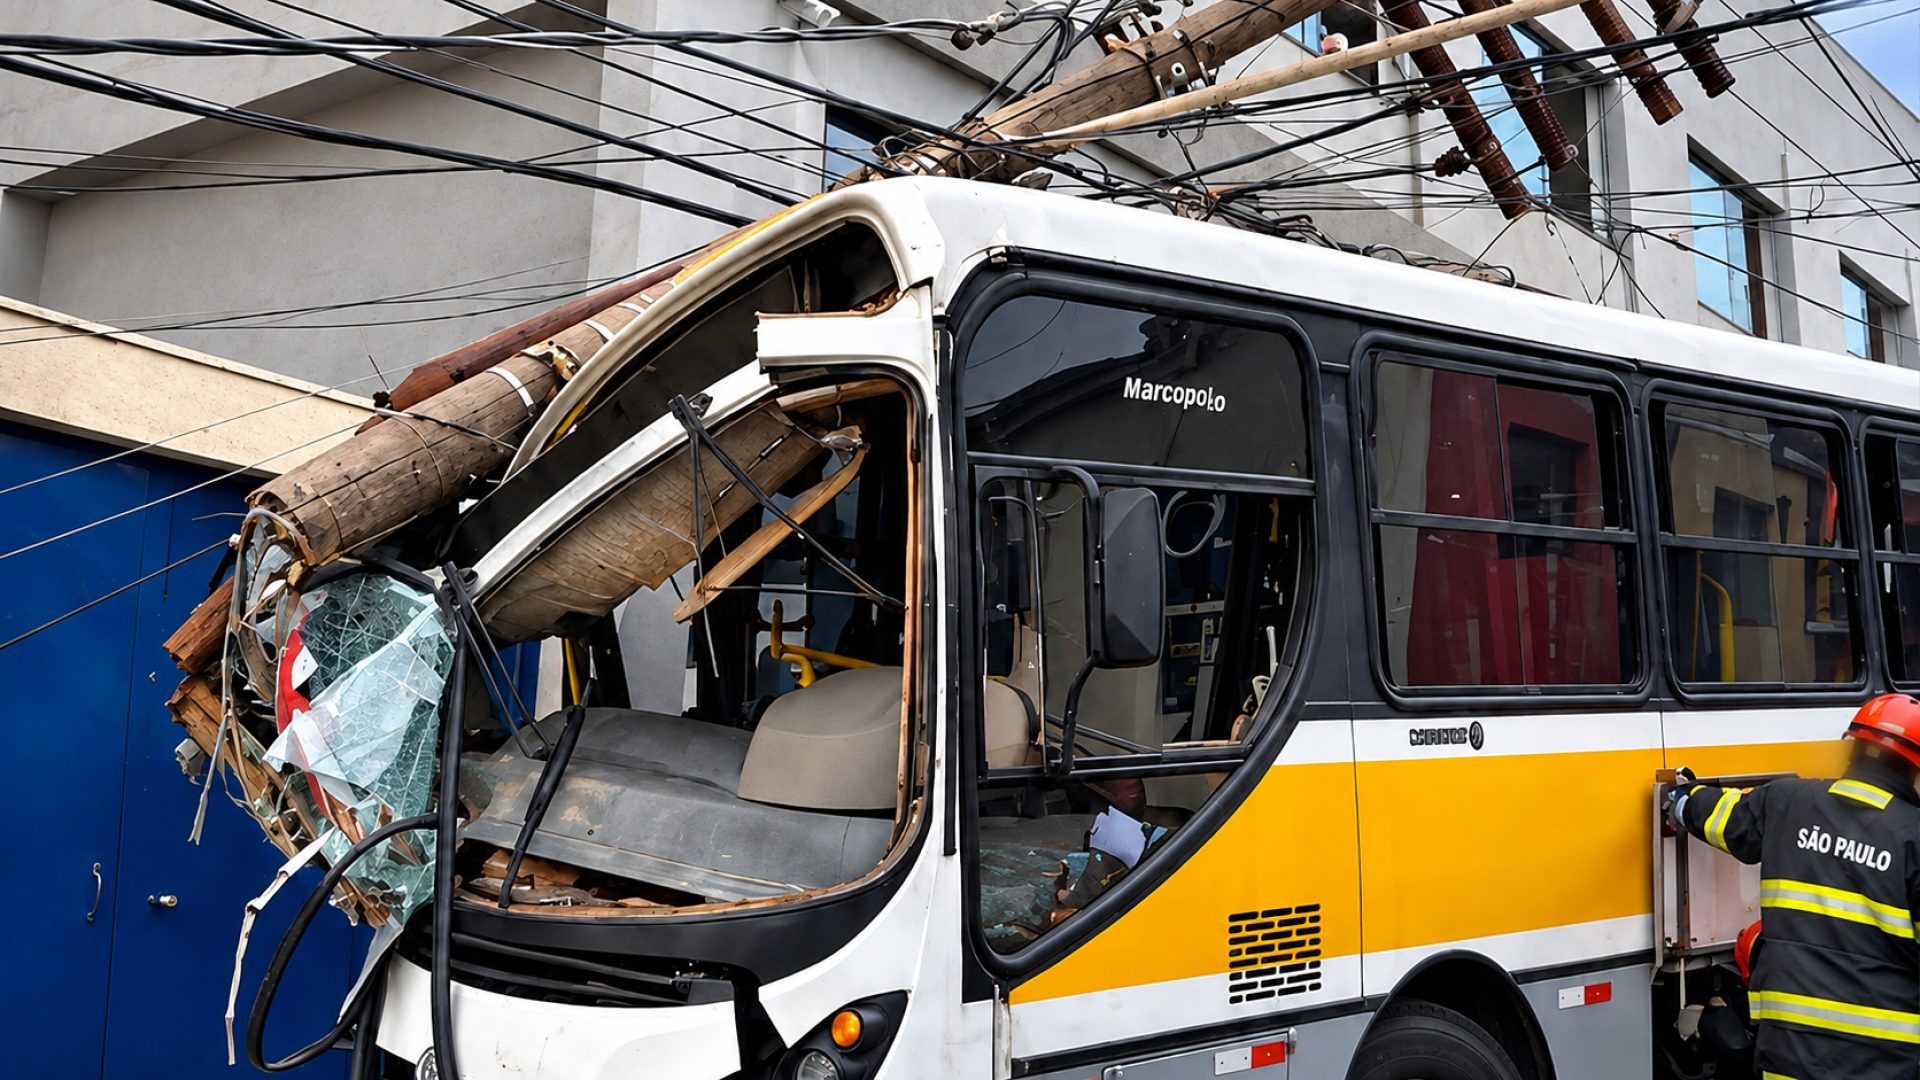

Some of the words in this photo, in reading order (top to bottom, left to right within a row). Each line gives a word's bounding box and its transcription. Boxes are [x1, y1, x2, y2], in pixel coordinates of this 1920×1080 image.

[1123, 376, 1226, 412] Marcopolo
[1797, 825, 1832, 854] SÃO
[1834, 836, 1892, 871] PAULO
